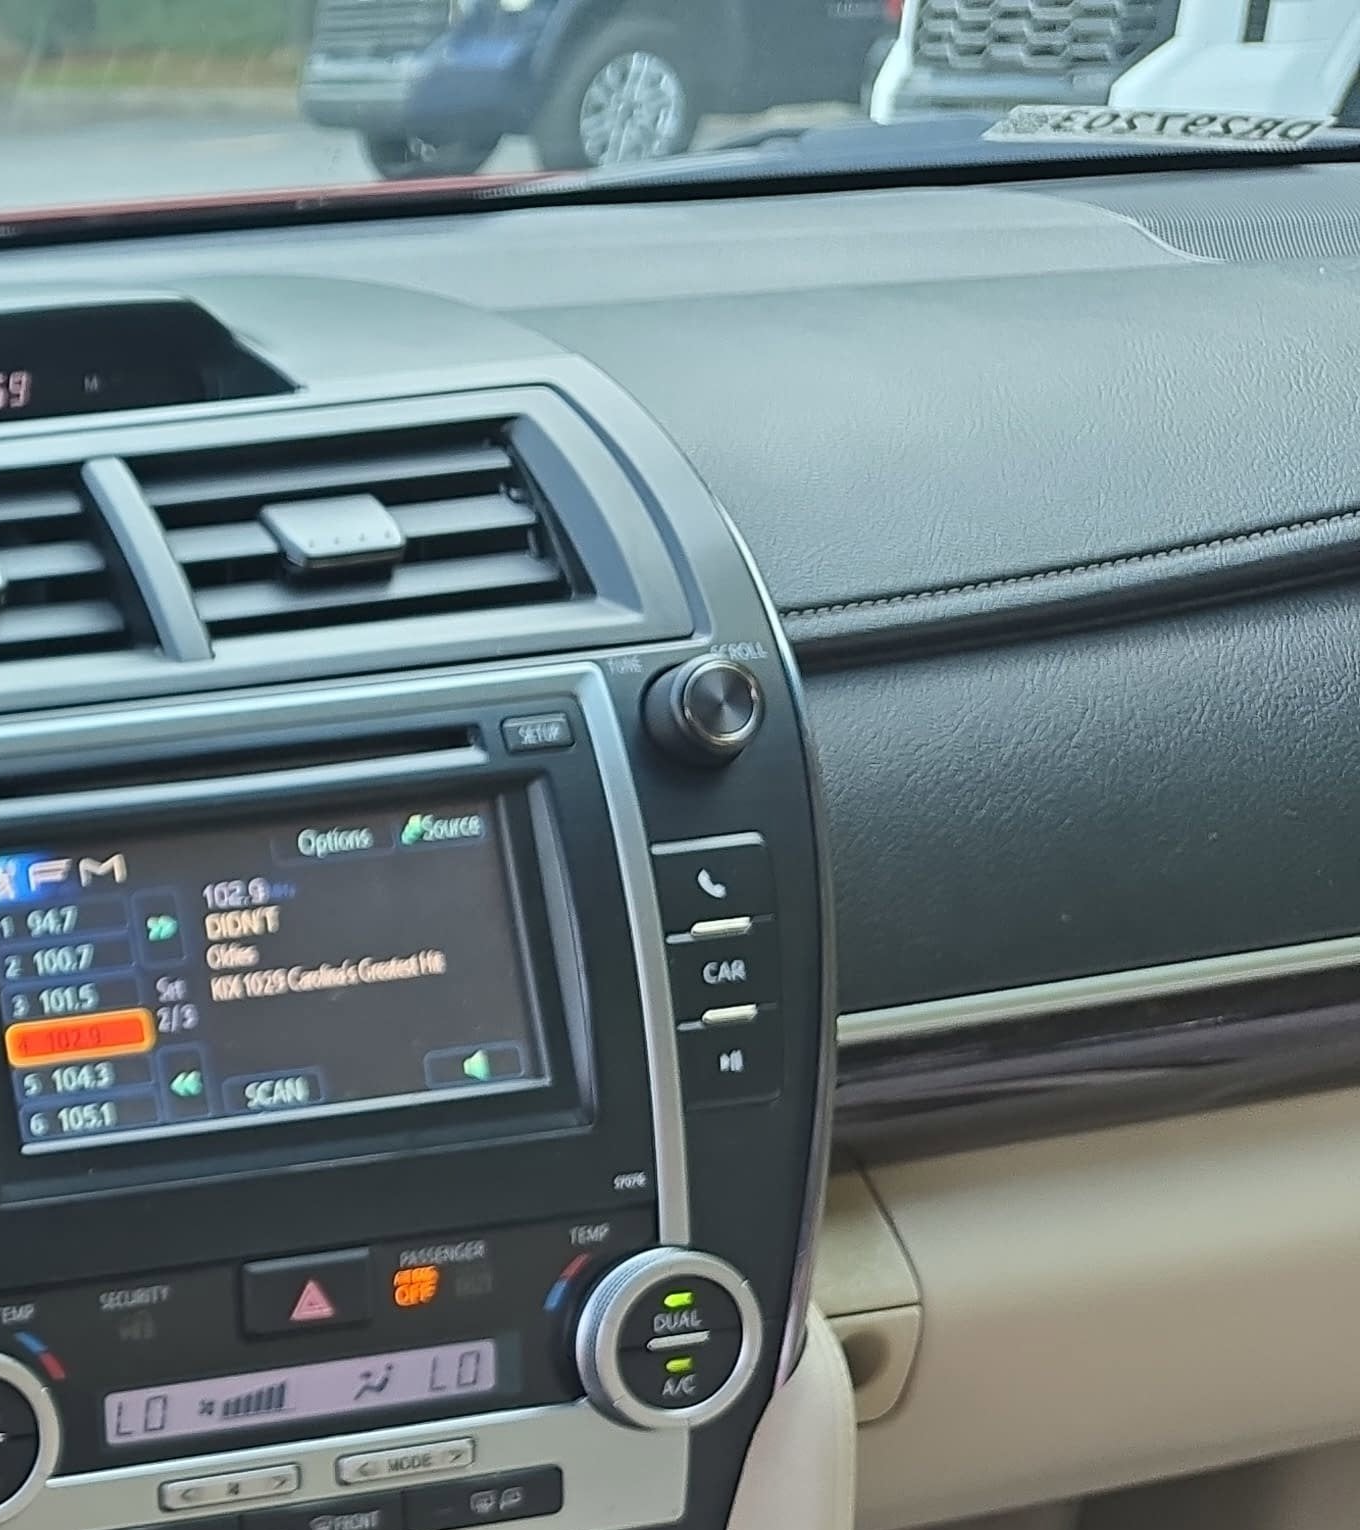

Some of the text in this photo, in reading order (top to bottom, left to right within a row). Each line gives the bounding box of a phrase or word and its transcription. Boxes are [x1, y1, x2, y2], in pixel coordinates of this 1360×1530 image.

[297, 827, 374, 858] Options
[420, 814, 482, 842] Source
[27, 854, 128, 893] FM
[203, 877, 271, 909] 102.9
[0, 905, 78, 939] 1 94.7
[4, 943, 95, 980] 2 100.7
[702, 960, 747, 985] CAR
[11, 982, 100, 1018] 3 101.5
[156, 1003, 200, 1034] 2/3
[46, 1024, 103, 1052] 102.9
[23, 1061, 116, 1097] 5 104.3
[244, 1076, 311, 1109] SCAN
[29, 1101, 119, 1137] 6 105.1
[568, 1223, 611, 1245] TEMP
[399, 1239, 486, 1268] PASSENGER
[99, 1285, 172, 1310] SECURITY
[395, 1282, 438, 1306] OFF
[653, 1313, 703, 1332] DUAL
[661, 1374, 698, 1397] A/C
[387, 1452, 434, 1474] MODE
